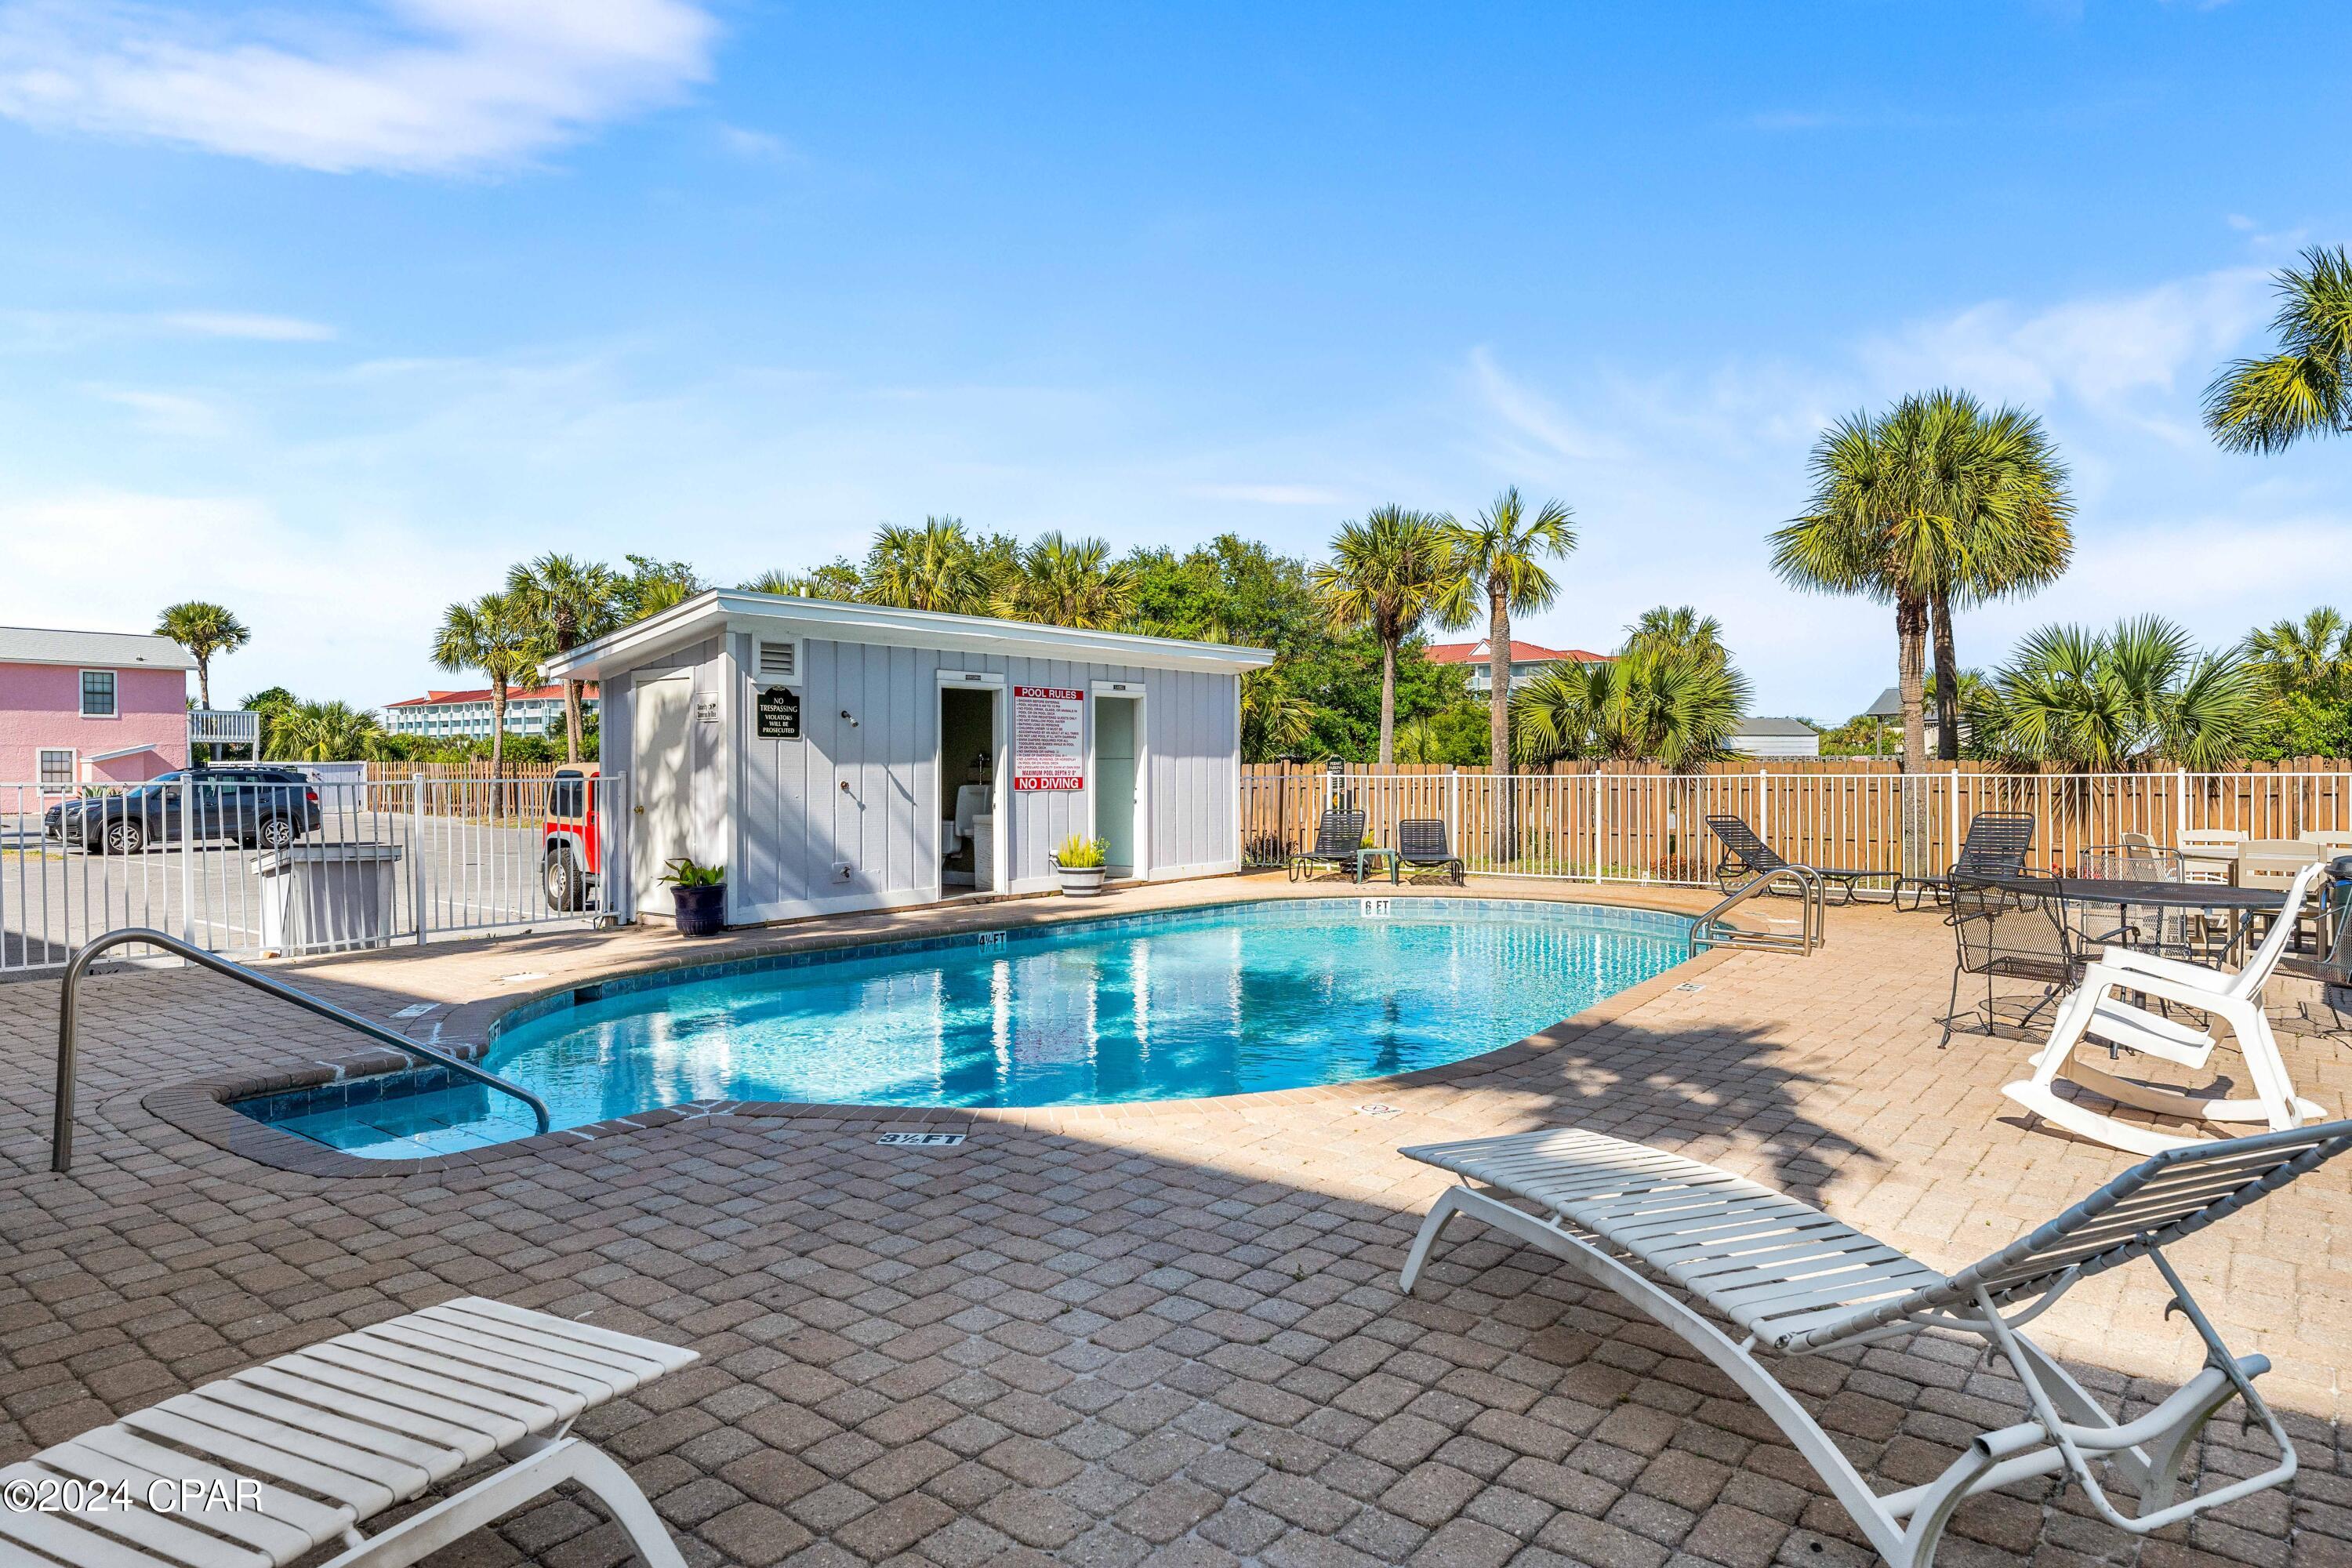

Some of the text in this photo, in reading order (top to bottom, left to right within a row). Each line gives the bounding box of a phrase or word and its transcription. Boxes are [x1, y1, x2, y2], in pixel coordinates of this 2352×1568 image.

[1022, 688, 1076, 699] POOL RULES
[1020, 778, 1078, 789] NO DIVING
[1365, 900, 1388, 909] 6 FT
[994, 933, 1005, 944] FT
[921, 1135, 963, 1144] FT
